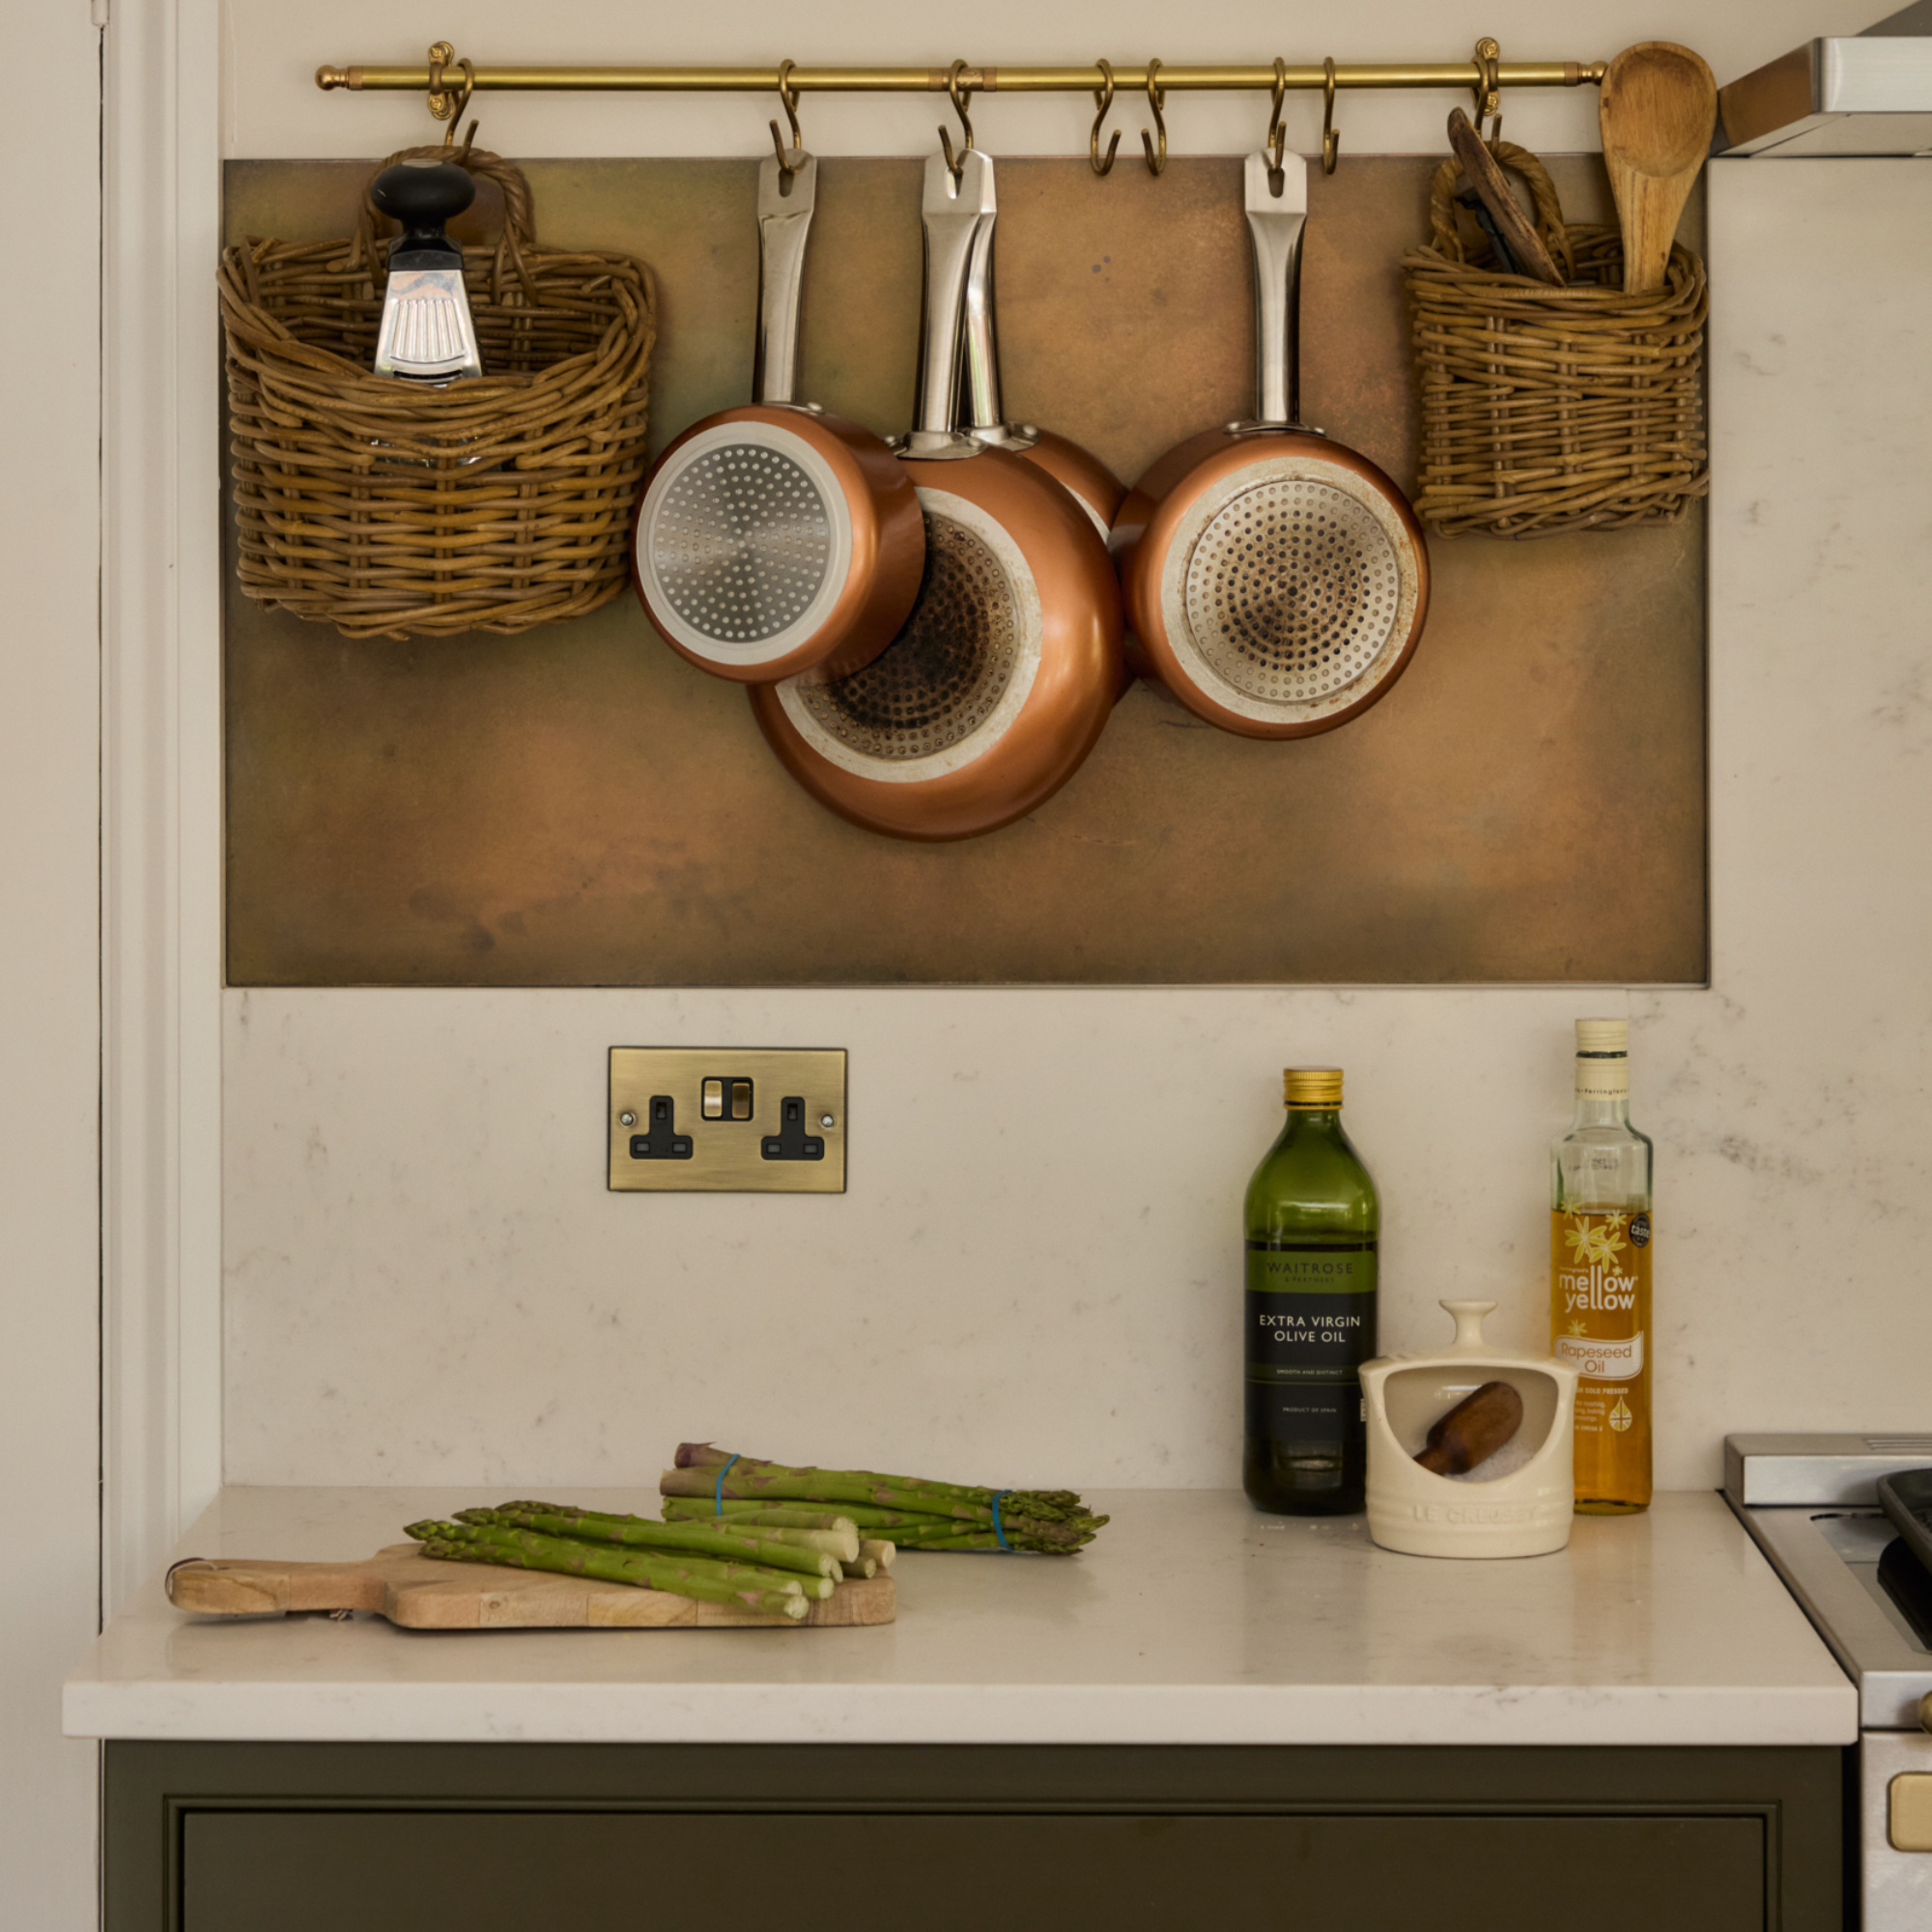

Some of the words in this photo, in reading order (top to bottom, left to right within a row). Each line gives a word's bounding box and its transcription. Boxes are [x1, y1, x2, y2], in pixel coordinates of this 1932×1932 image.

[1267, 1262, 1353, 1274] WAITROSE
[1559, 1264, 1635, 1293] mellow
[1565, 1293, 1635, 1313] yellow
[1259, 1314, 1306, 1327] EXTRA
[1311, 1316, 1360, 1327] VIRGIN
[1274, 1330, 1316, 1342] OLIVE
[1321, 1331, 1346, 1343] OIL
[1561, 1342, 1632, 1360] Rapeseed
[1584, 1359, 1605, 1373] Oil
[1413, 1504, 1437, 1522] LE
